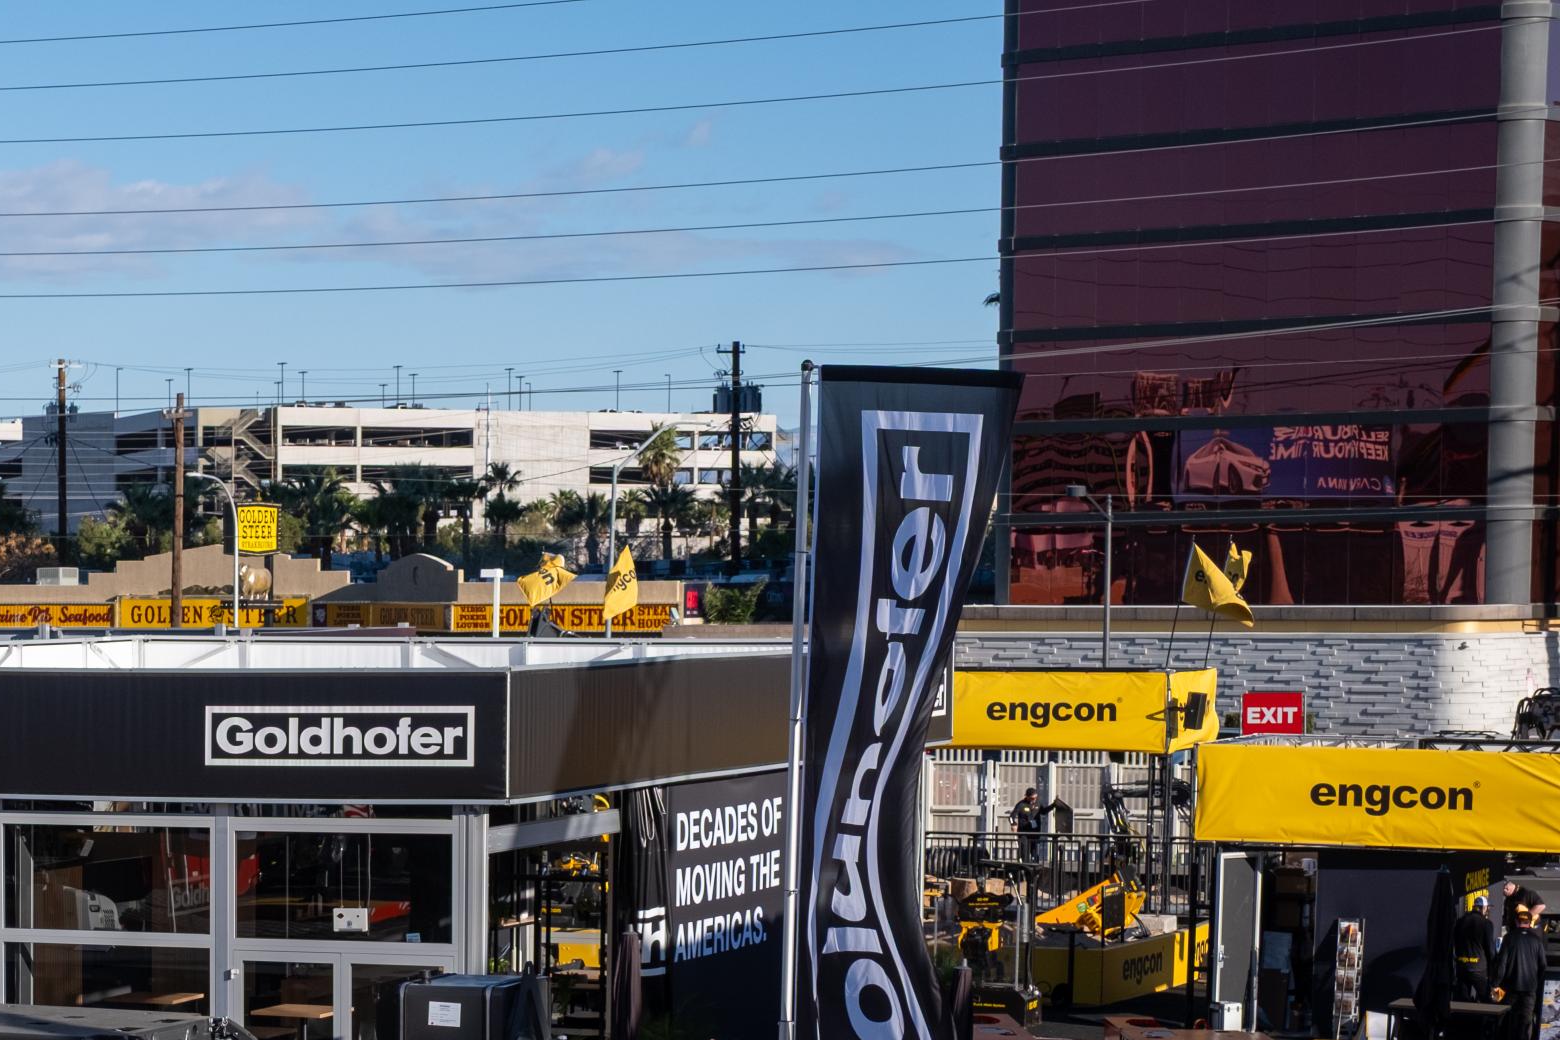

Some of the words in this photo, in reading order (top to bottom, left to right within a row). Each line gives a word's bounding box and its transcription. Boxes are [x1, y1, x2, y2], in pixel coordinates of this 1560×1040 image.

[239, 507, 276, 523] GOLDEN
[241, 525, 273, 540] STEER
[58, 605, 111, 628] Seafood
[130, 604, 203, 625] GOLEN
[637, 606, 668, 616] STEA
[637, 619, 670, 629] HOUS
[1246, 706, 1299, 724] EXIT
[214, 716, 464, 756] Goldhofer
[676, 801, 758, 851] DECADES
[761, 796, 782, 837] OF
[675, 857, 746, 908] MOVING
[749, 849, 781, 892] THE
[674, 905, 767, 963] AMERICAS.
[1122, 950, 1163, 984] engcon
